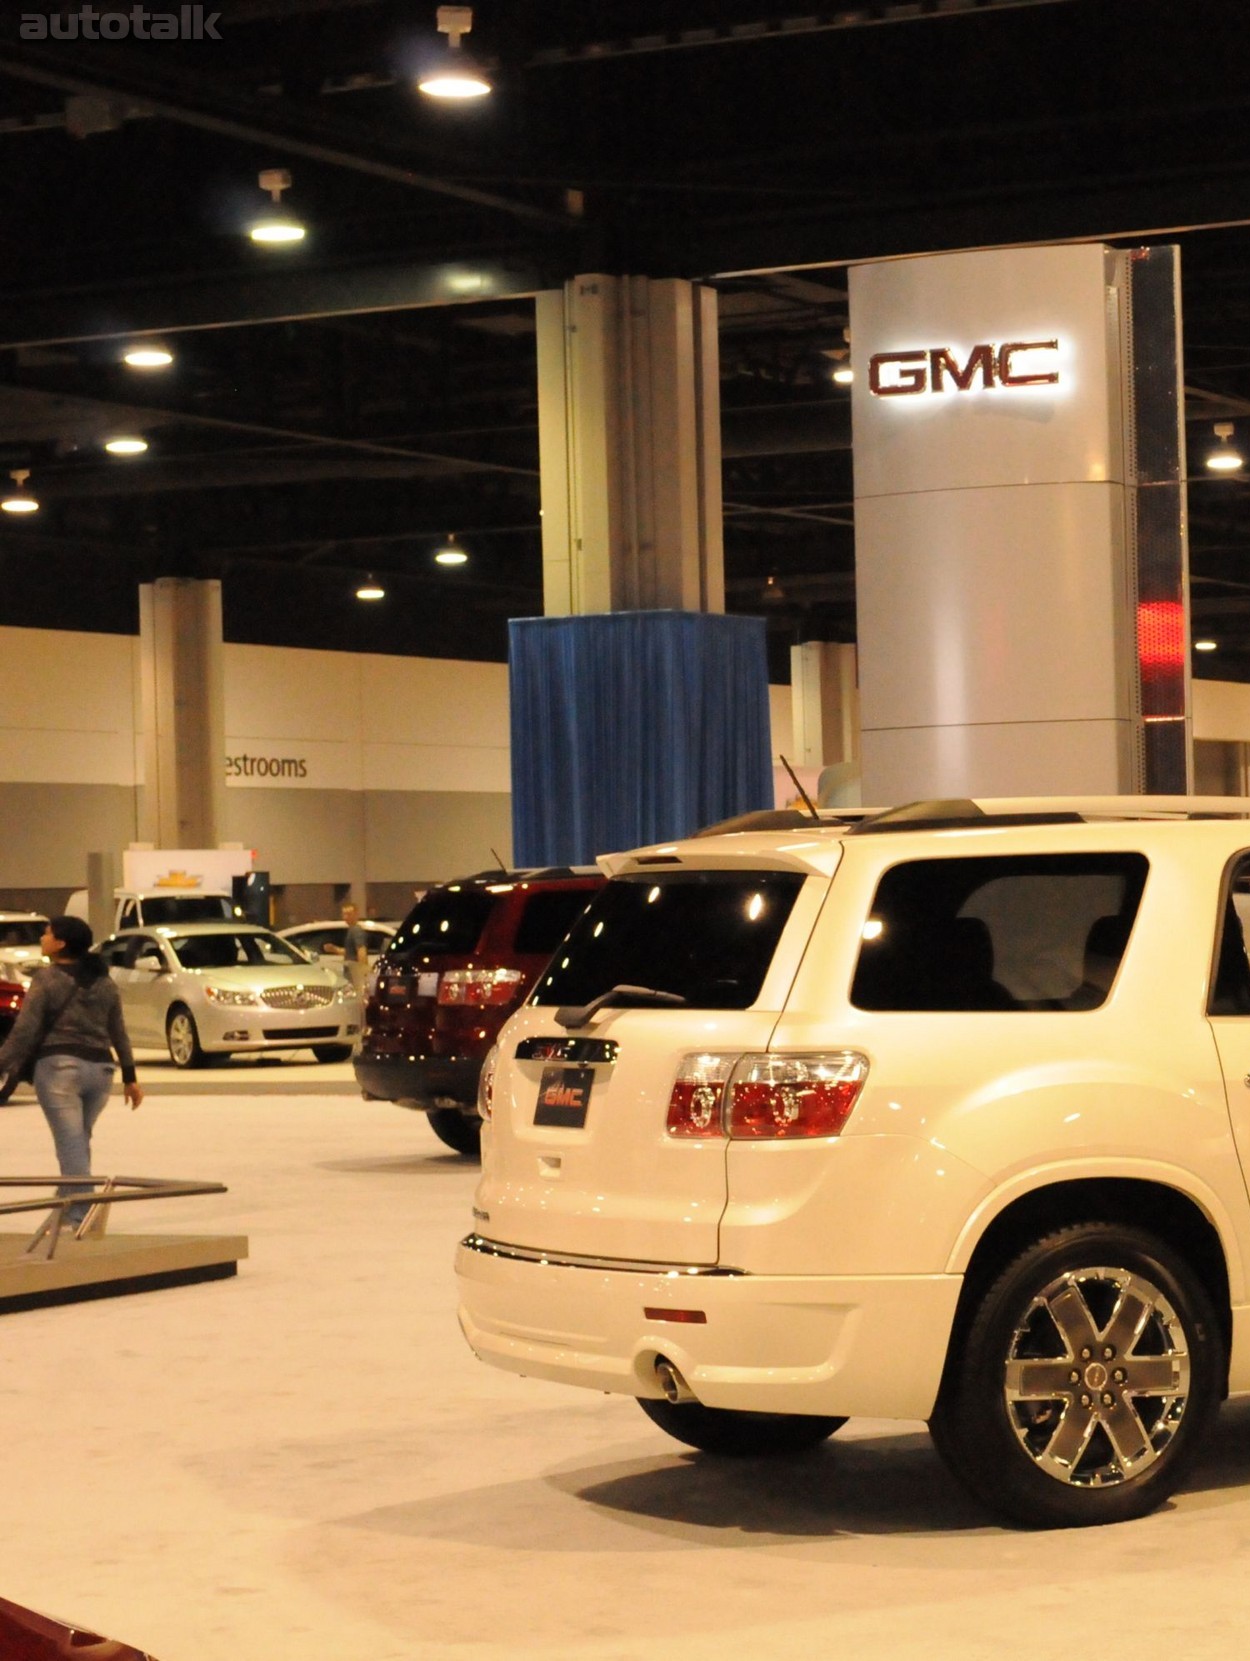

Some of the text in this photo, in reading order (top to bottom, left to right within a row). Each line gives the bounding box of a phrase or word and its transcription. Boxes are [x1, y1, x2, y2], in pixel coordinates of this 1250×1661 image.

[868, 338, 1059, 397] GMC
[225, 754, 307, 778] estrooms
[543, 1087, 583, 1107] GMC
